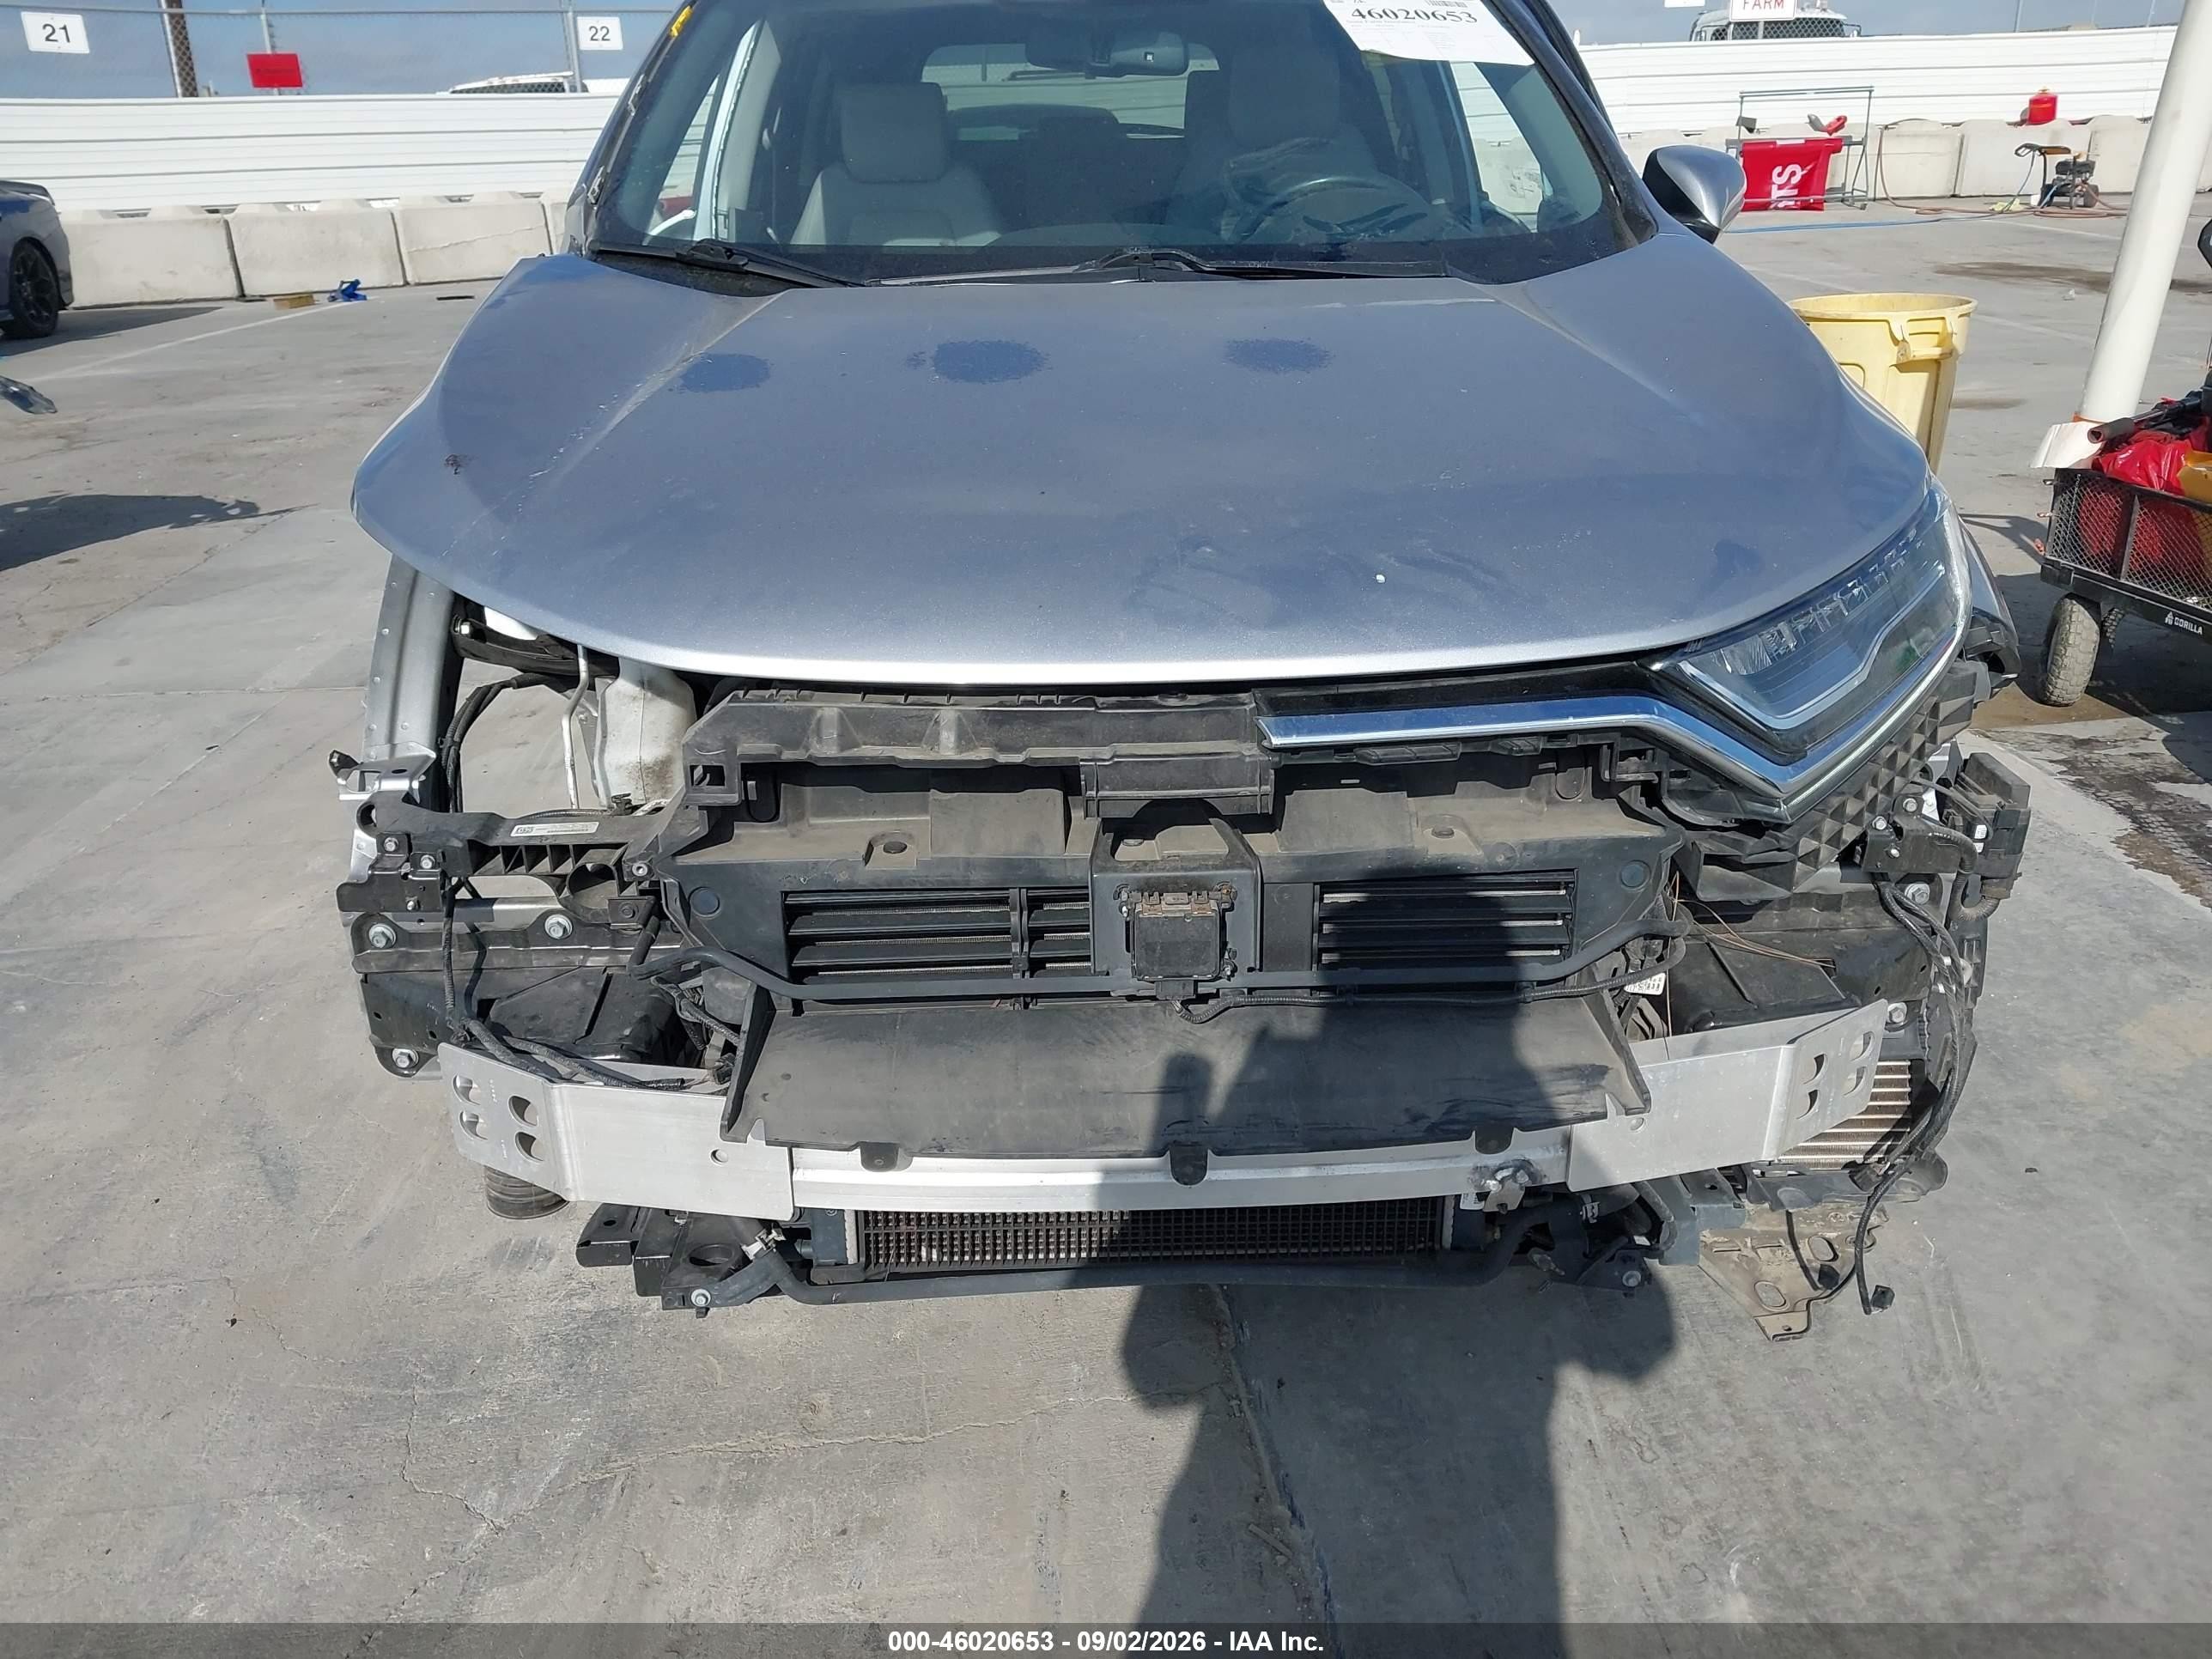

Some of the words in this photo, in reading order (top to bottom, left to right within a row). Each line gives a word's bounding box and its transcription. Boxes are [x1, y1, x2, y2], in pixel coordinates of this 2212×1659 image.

[1352, 8, 1478, 23] 46020653
[42, 23, 70, 43] 21
[589, 26, 611, 41] 22
[2174, 617, 2203, 635] GORILLA
